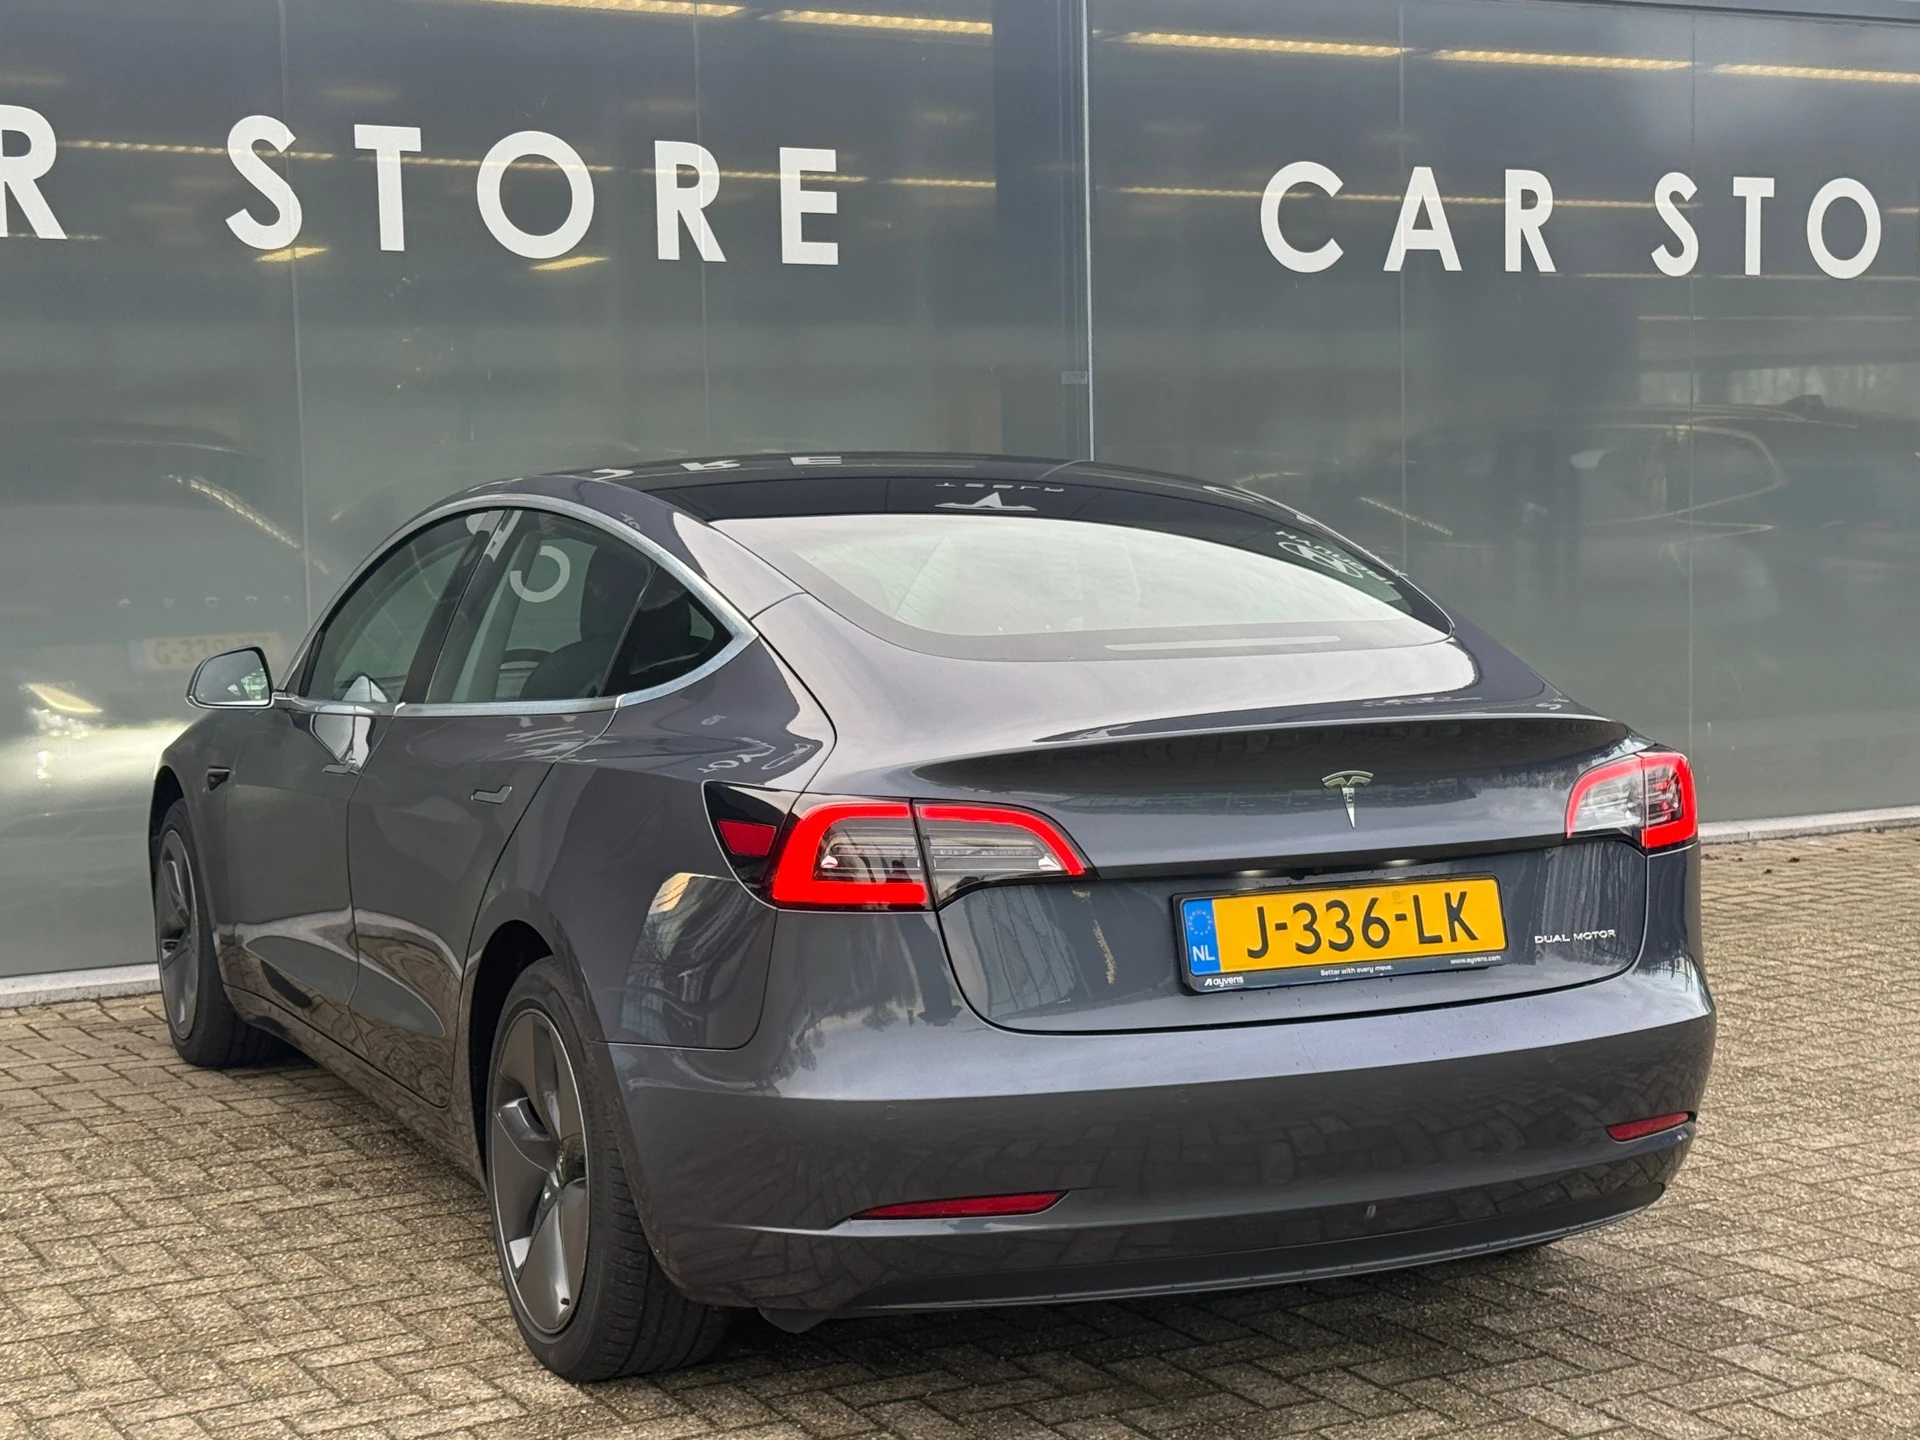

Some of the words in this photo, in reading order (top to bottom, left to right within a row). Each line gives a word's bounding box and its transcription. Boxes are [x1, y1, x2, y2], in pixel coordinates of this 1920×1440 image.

[226, 115, 839, 264] STORE
[1260, 161, 1557, 272] CAR
[1651, 171, 1882, 279] STO
[1246, 891, 1479, 960] J-336-LK
[1534, 934, 1571, 944] DUAL
[1573, 929, 1616, 941] MOTOR
[1192, 945, 1216, 962] NL
[1450, 955, 1502, 965] www.ayvens.com
[1356, 966, 1374, 974] every
[1212, 976, 1244, 988] ayvens
